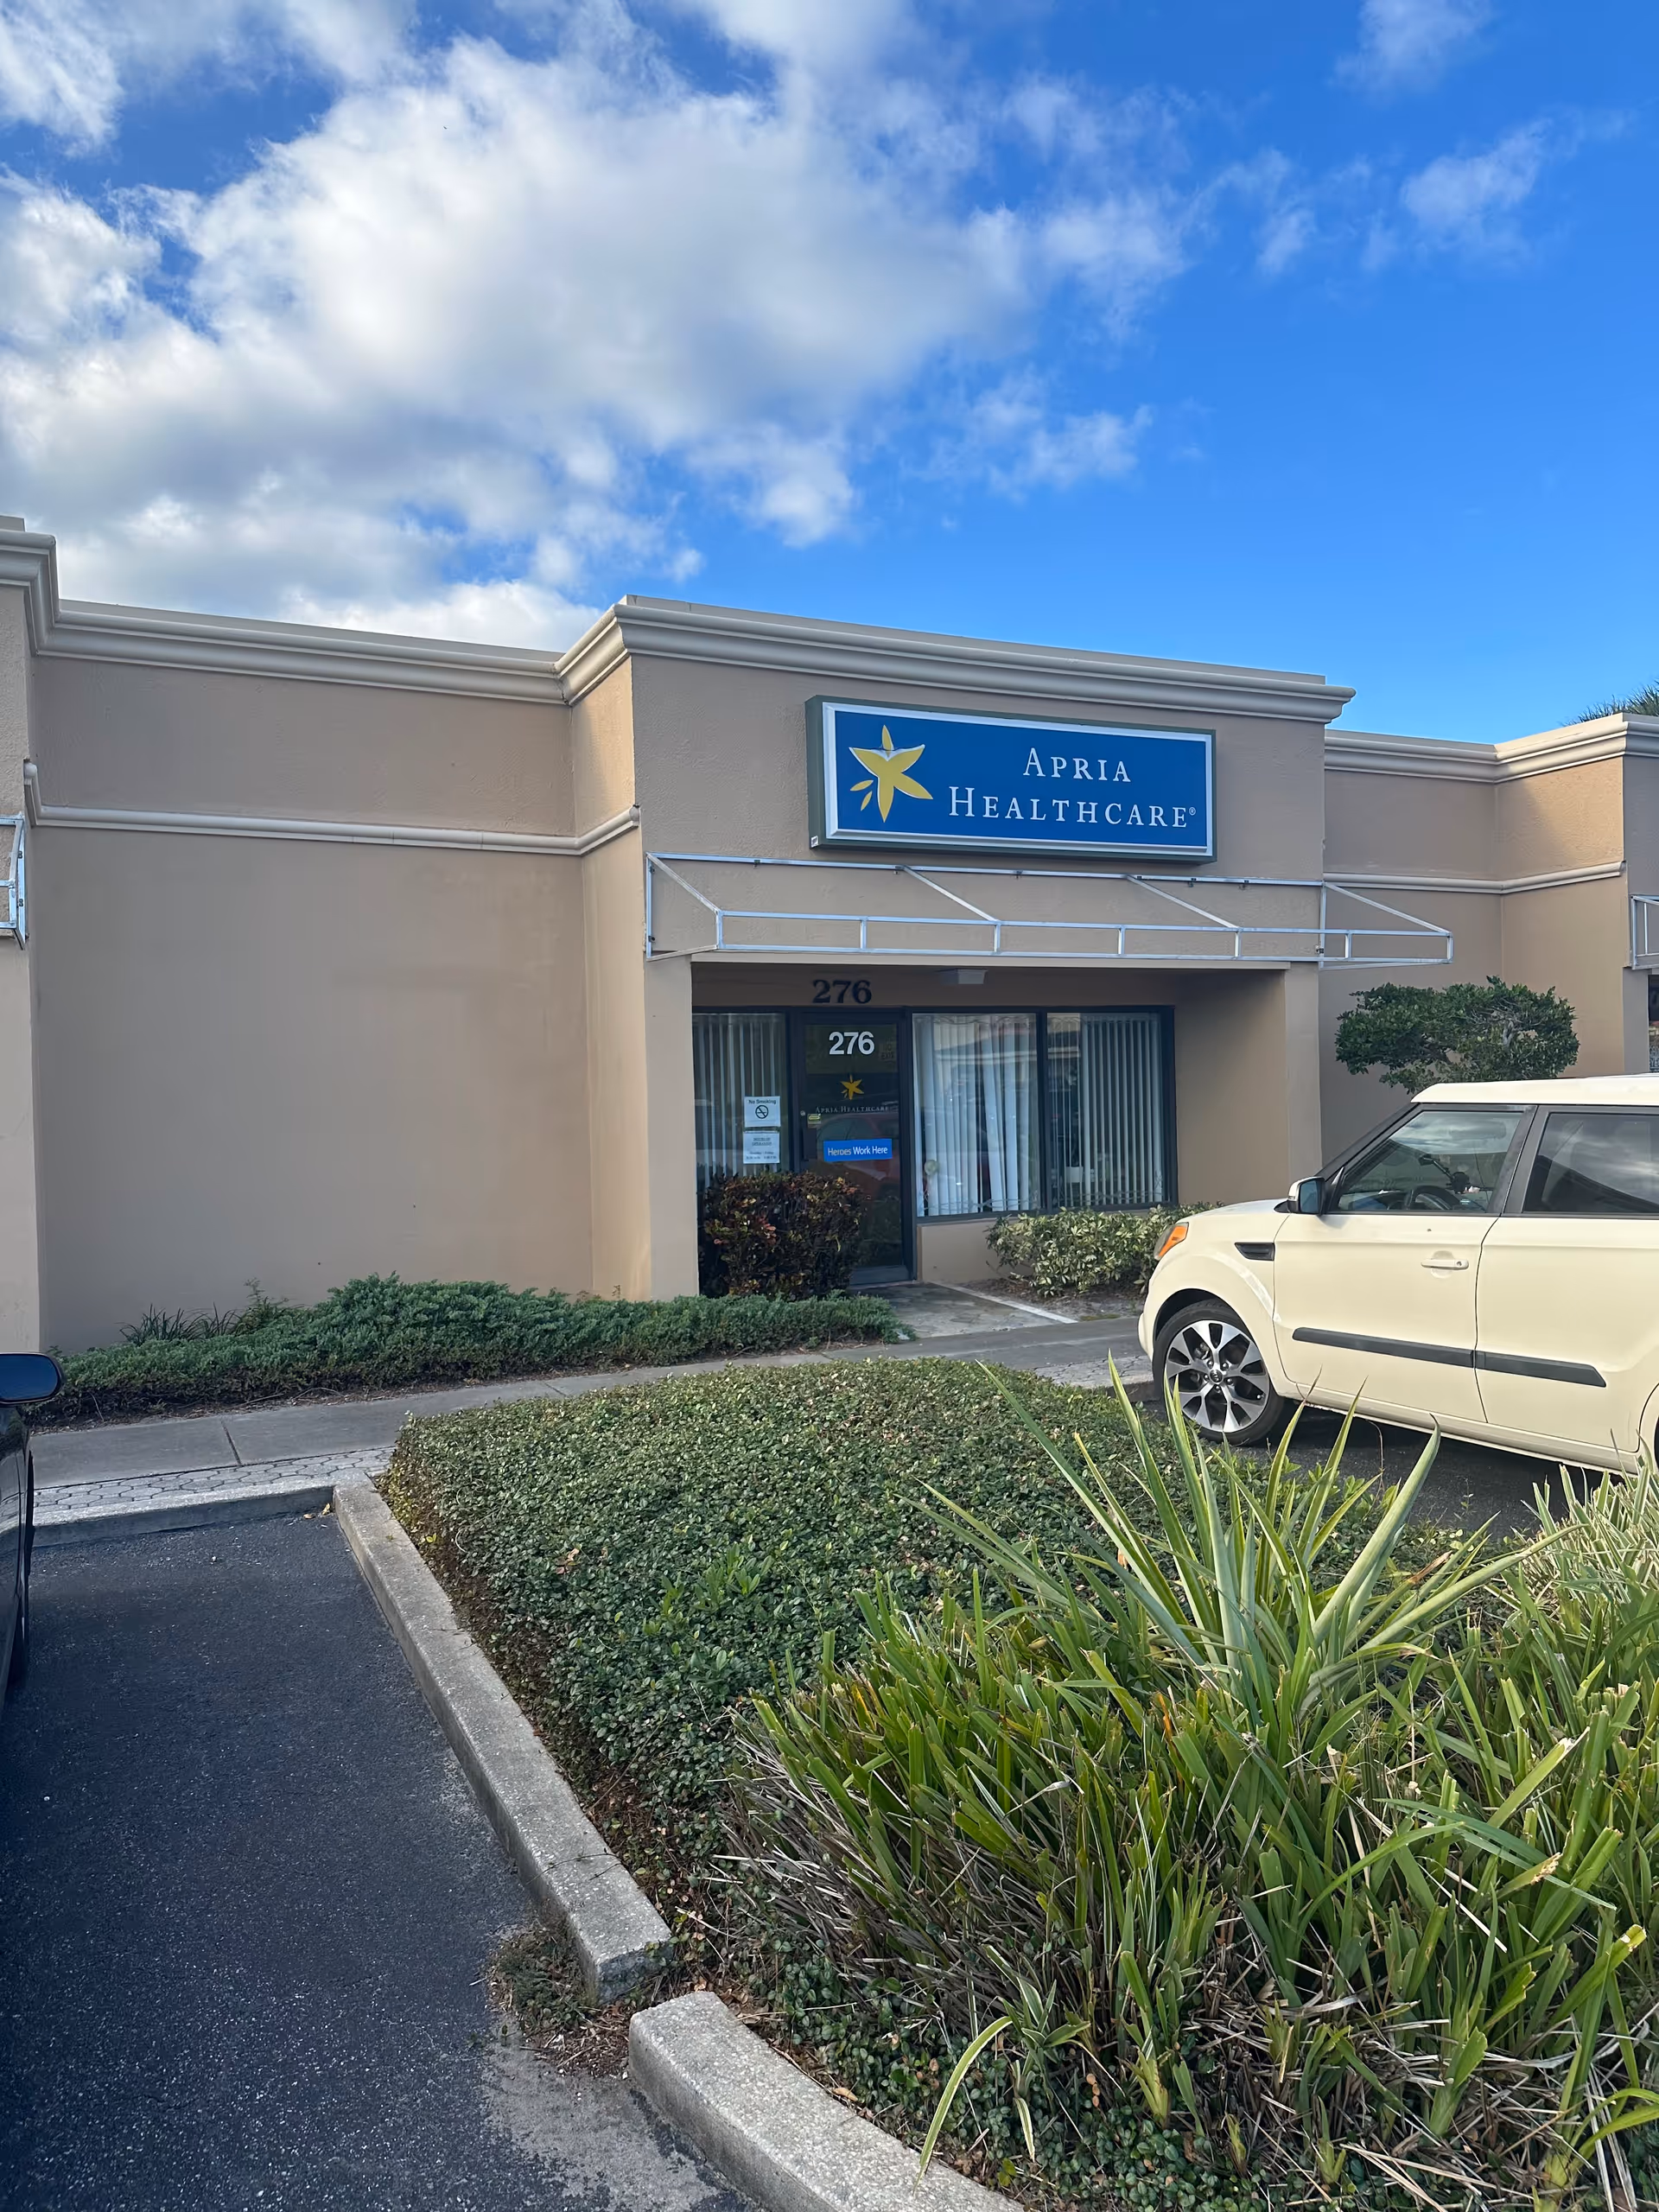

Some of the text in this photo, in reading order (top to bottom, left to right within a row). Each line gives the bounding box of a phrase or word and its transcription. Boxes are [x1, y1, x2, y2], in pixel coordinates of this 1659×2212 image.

[1023, 747, 1131, 782] APRIA
[812, 979, 872, 1004] 276
[829, 1031, 874, 1055] 276
[827, 1146, 888, 1156] Heroes Work Here
